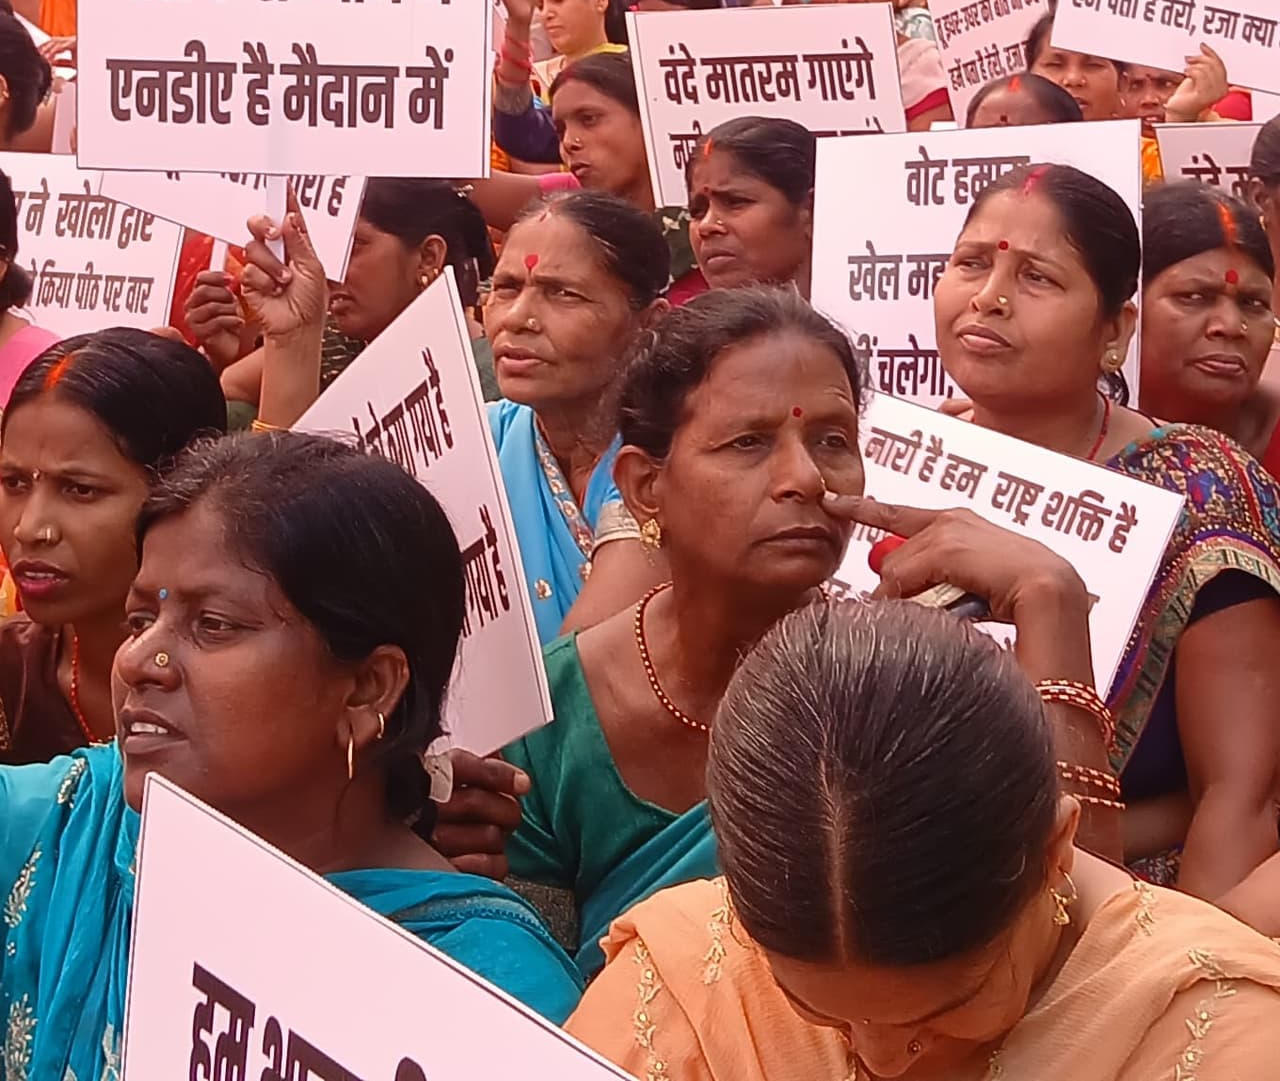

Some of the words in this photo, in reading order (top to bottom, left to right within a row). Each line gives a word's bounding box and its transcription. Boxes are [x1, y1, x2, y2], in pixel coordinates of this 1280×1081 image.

[934, 18, 949, 50] तू
[942, 3, 981, 41] इधर-उधर
[1203, 6, 1240, 39] रजा
[1242, 15, 1277, 48] क्या
[106, 39, 237, 125] एनडीए
[243, 41, 275, 126] है
[280, 42, 400, 129] मैदान
[406, 45, 454, 130] में
[659, 43, 699, 105] वंदे
[700, 55, 801, 103] मातरम
[803, 36, 876, 100] गाएंगे
[948, 58, 965, 91] हमें
[963, 58, 980, 87] पता
[975, 50, 988, 81] है
[1004, 43, 1024, 71] रजा
[905, 145, 948, 206] वोट
[26, 178, 50, 236] ने
[56, 179, 117, 240] खोला
[118, 206, 155, 249] द्वार
[36, 259, 75, 308] किया
[76, 261, 103, 310] पीठ
[103, 275, 126, 312] पर
[126, 276, 155, 314] वार
[848, 240, 903, 301] खेल
[422, 347, 453, 450] है
[877, 334, 953, 399] चलेगा,
[405, 380, 442, 467] गया
[864, 427, 924, 476] नारी
[918, 435, 945, 483] है
[940, 453, 988, 500] हम
[991, 471, 1044, 527] राष्ट्र
[1041, 489, 1112, 542] शक्ति
[1108, 502, 1138, 554] है
[479, 504, 510, 612] है
